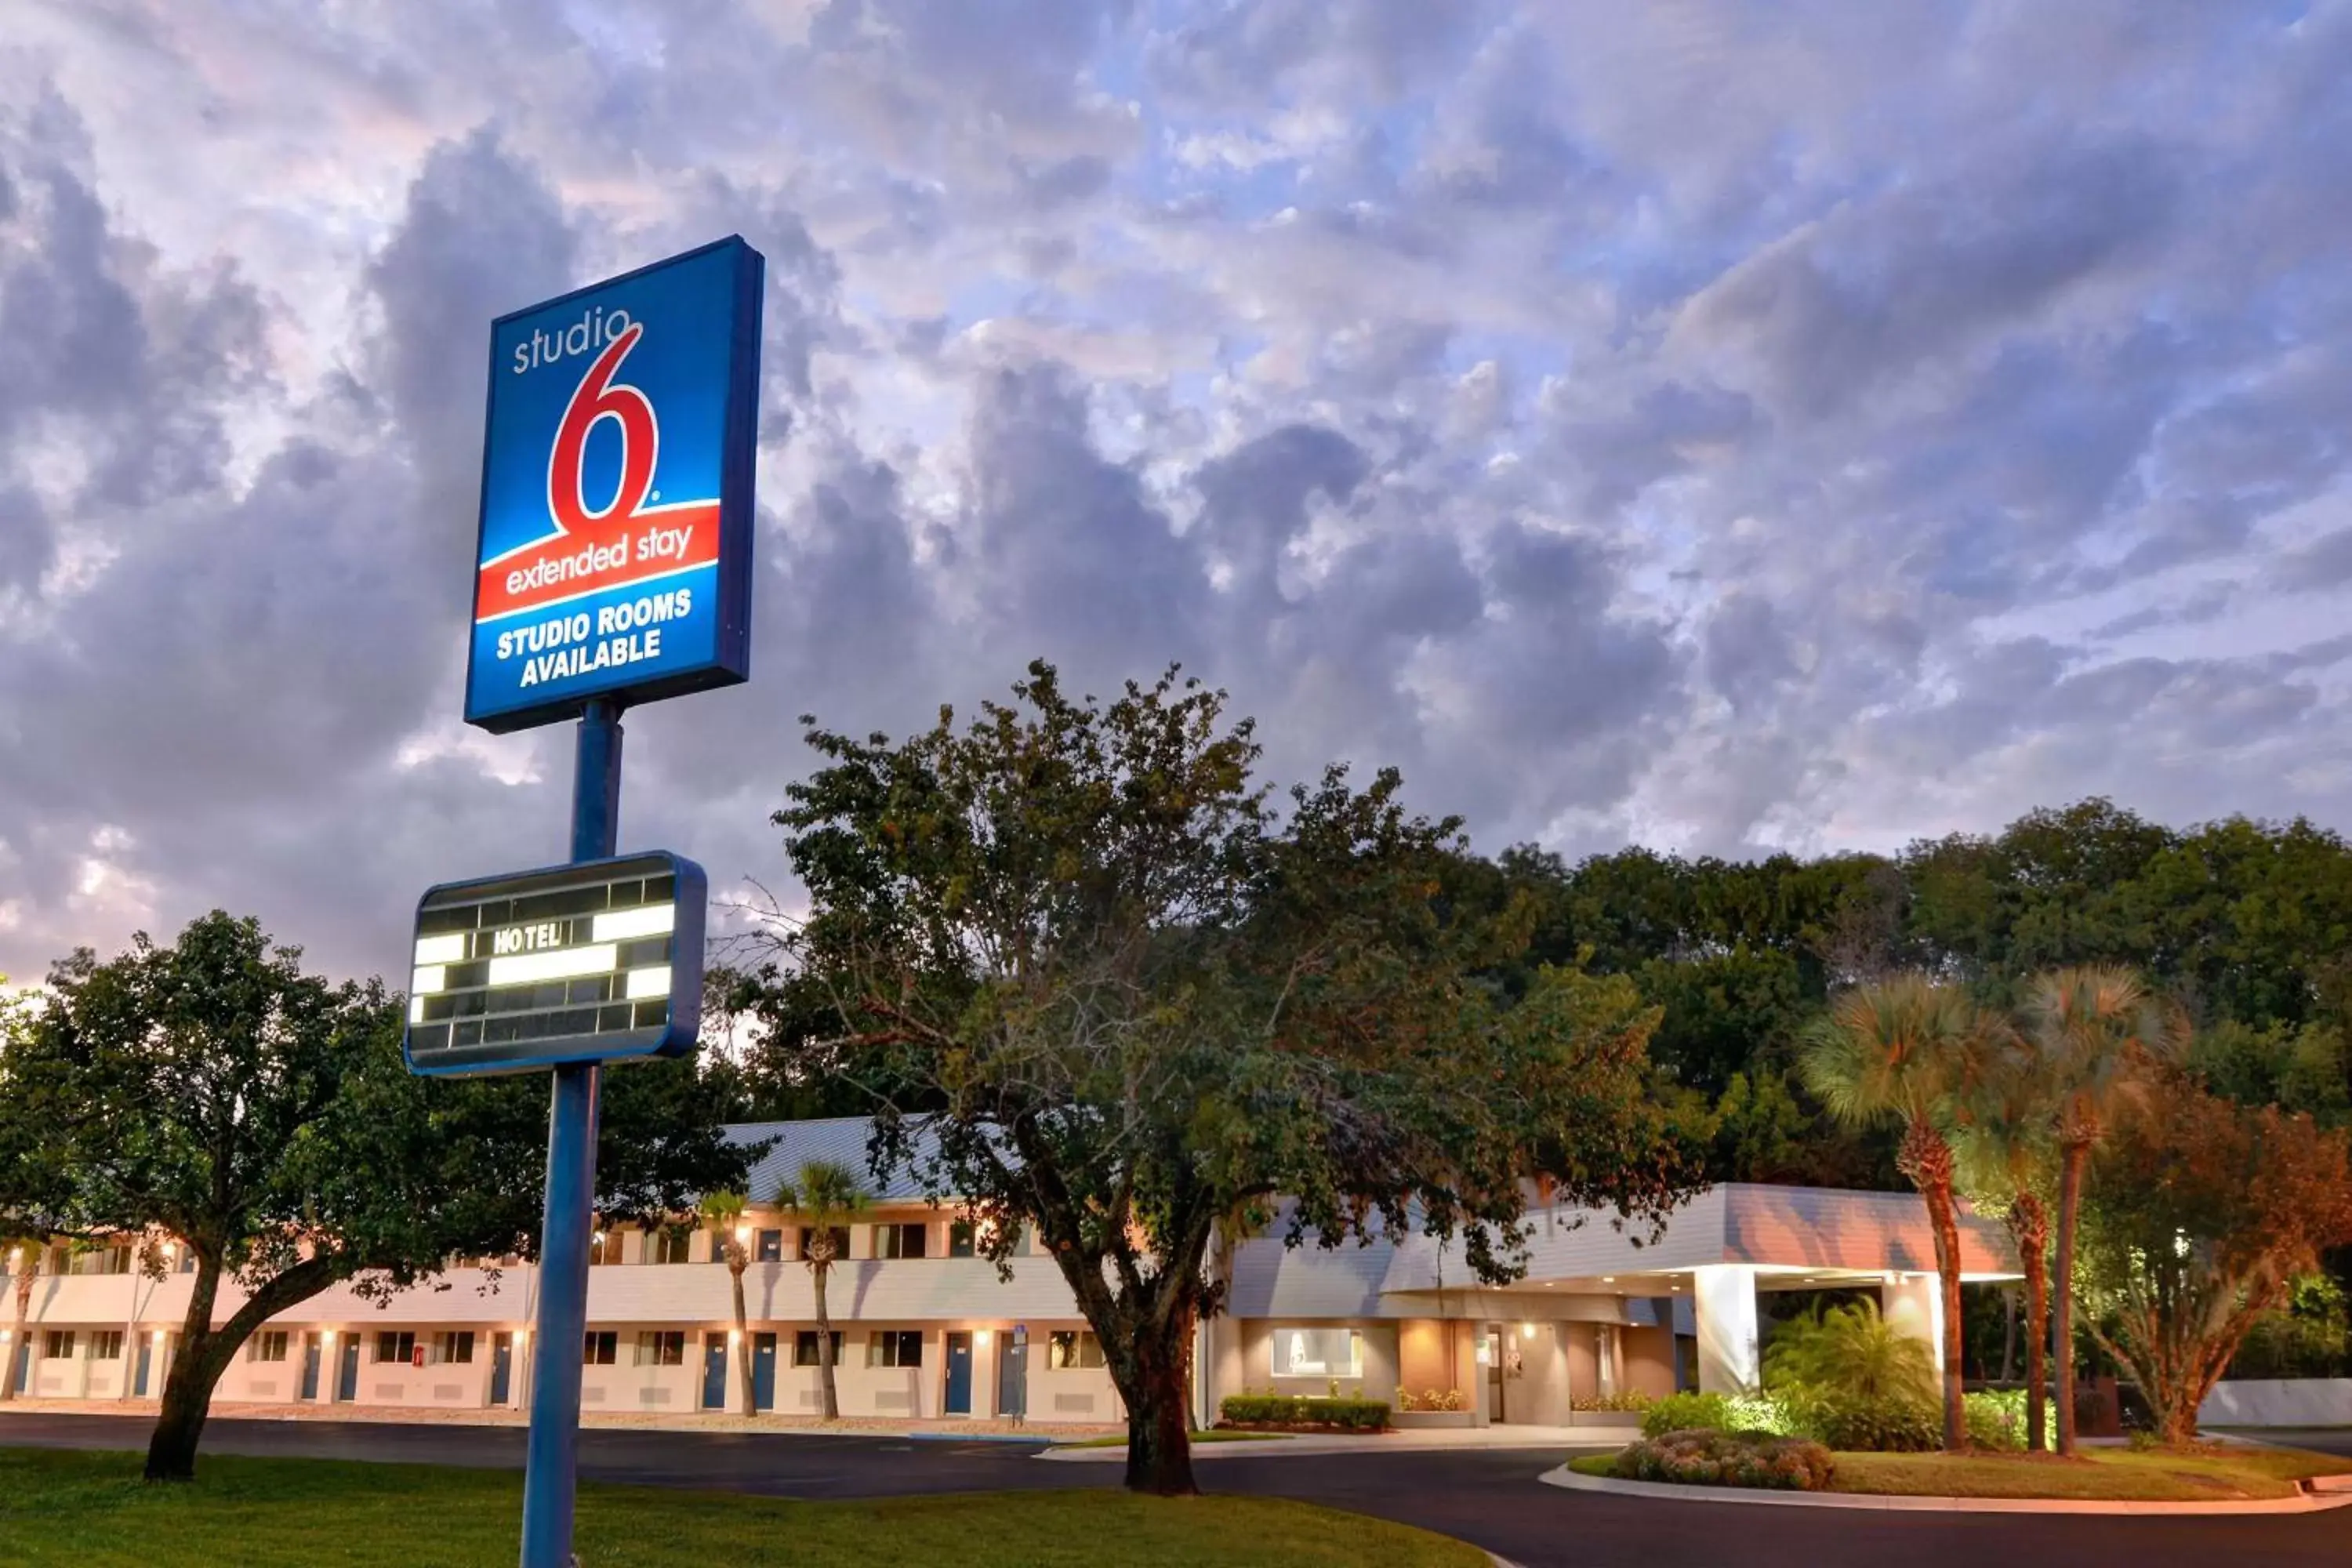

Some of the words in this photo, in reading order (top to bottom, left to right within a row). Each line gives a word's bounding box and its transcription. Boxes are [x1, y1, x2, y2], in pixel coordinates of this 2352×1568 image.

[513, 307, 630, 374] studio
[547, 322, 659, 535] 6
[506, 535, 627, 593] extended
[637, 525, 693, 561] stay
[496, 613, 590, 659] STUDIO
[597, 588, 691, 635] ROOMS
[519, 630, 661, 688] AVAILABLE
[494, 922, 560, 954] HOTEL
